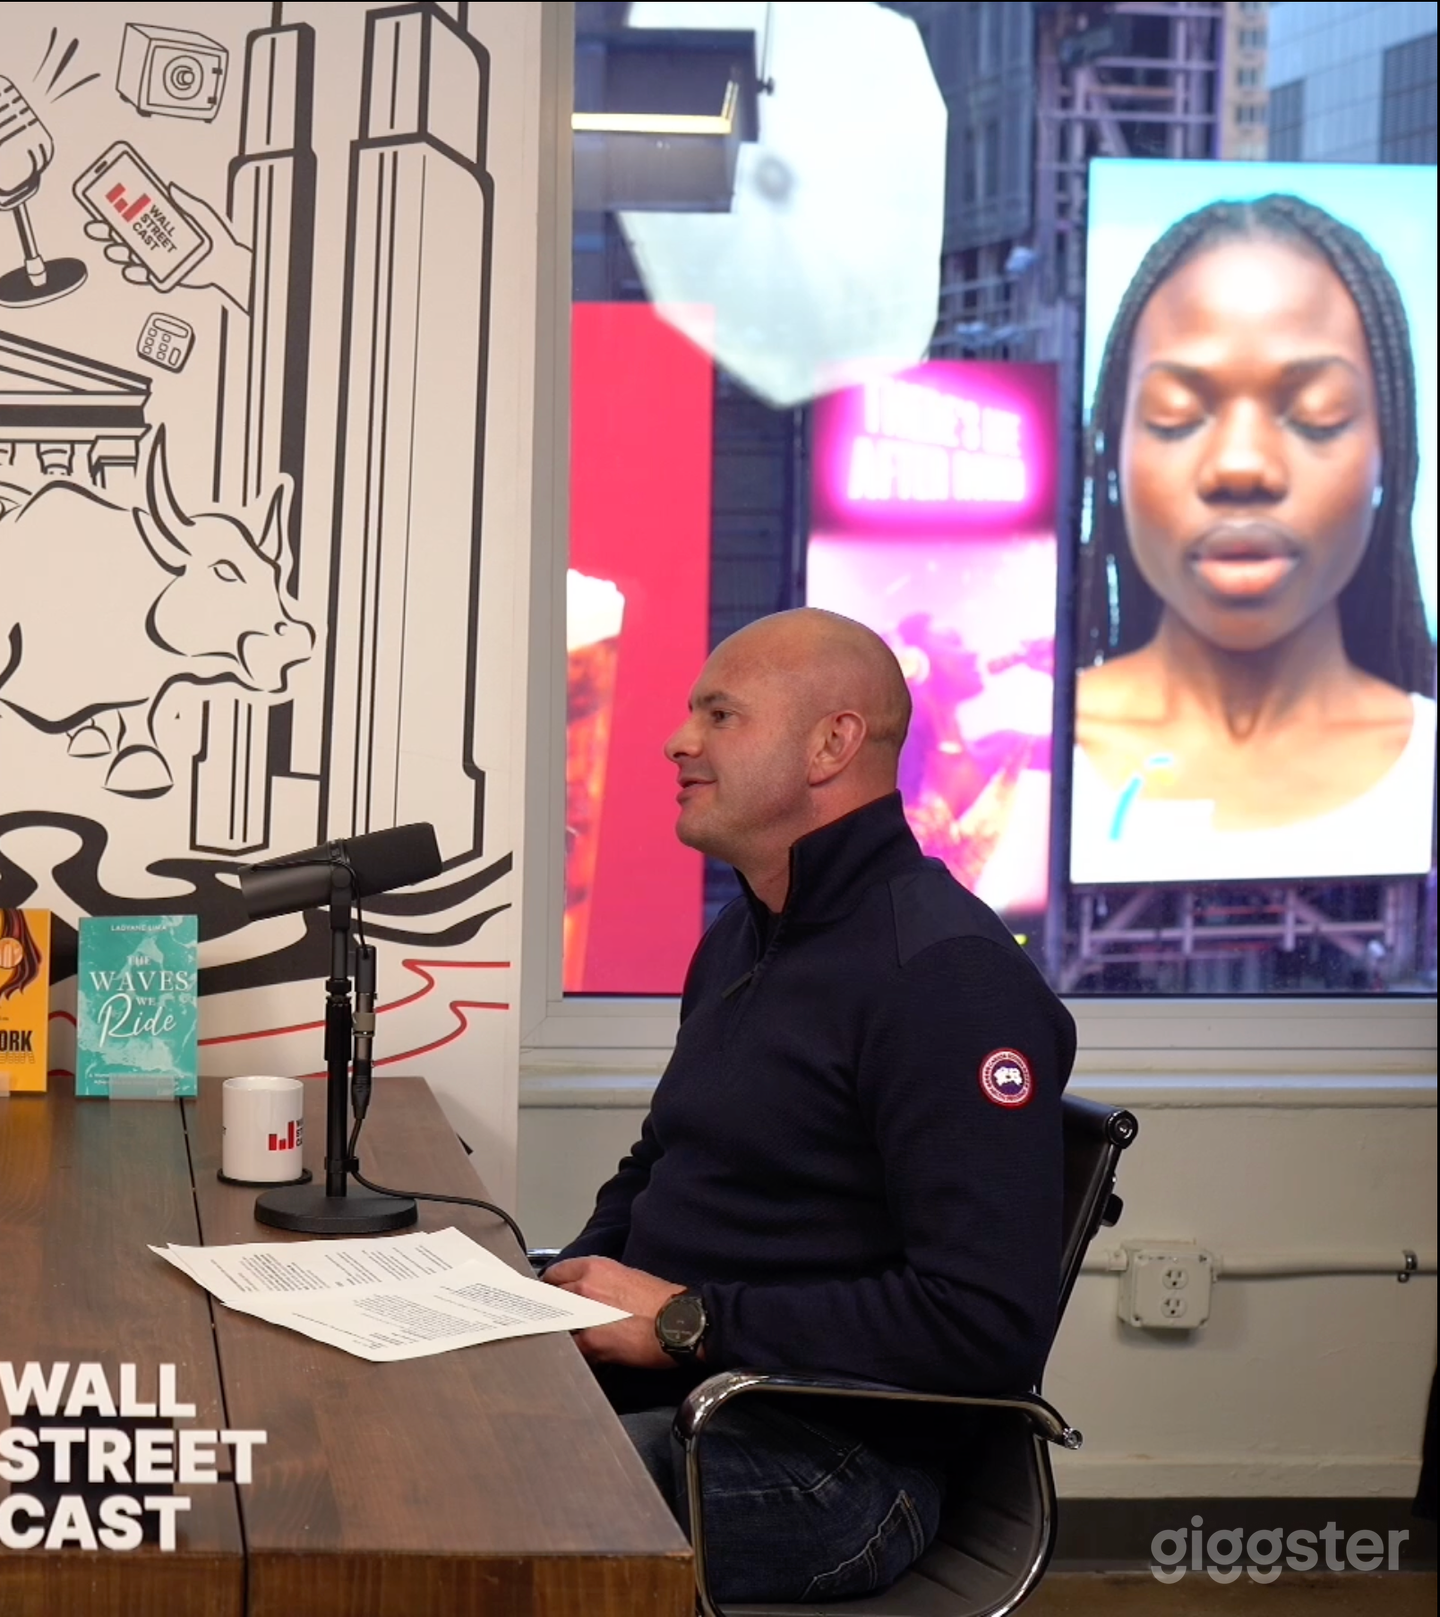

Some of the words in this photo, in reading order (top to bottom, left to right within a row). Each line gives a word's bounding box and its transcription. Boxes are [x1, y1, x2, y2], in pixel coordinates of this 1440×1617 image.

[140, 213, 178, 253] STREET
[150, 204, 175, 237] WALL
[133, 222, 160, 251] CAST
[89, 970, 189, 991] WAVES
[136, 996, 156, 1006] WE
[97, 993, 177, 1048] Ride
